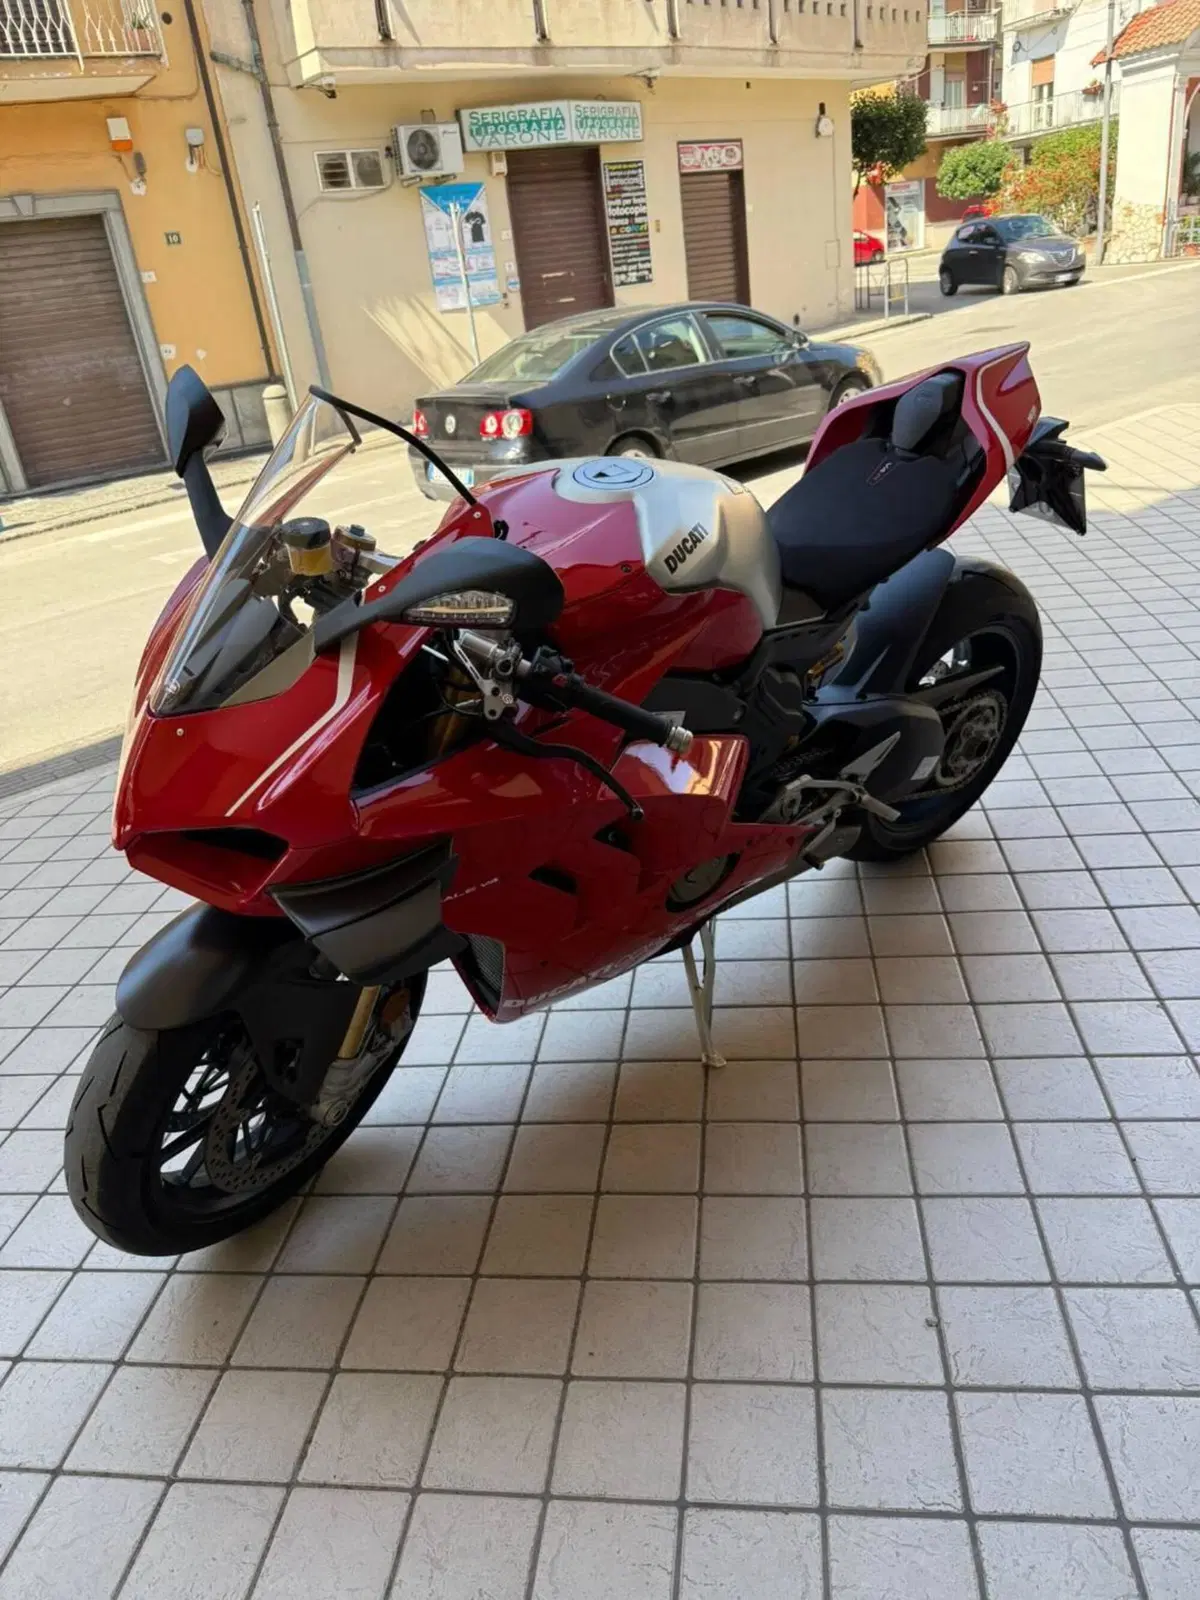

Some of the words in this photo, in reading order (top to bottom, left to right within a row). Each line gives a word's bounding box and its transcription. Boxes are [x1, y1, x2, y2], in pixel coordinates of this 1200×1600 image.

[469, 107, 565, 125] SERIGRAFIA
[575, 104, 639, 116] SERIGRAFIA
[470, 119, 565, 136] TIPOGRAFIA
[575, 117, 640, 130] TIPOGRAFIA
[471, 131, 568, 147] VARONE
[577, 127, 641, 139] VARONE
[664, 522, 709, 575] DUCATI
